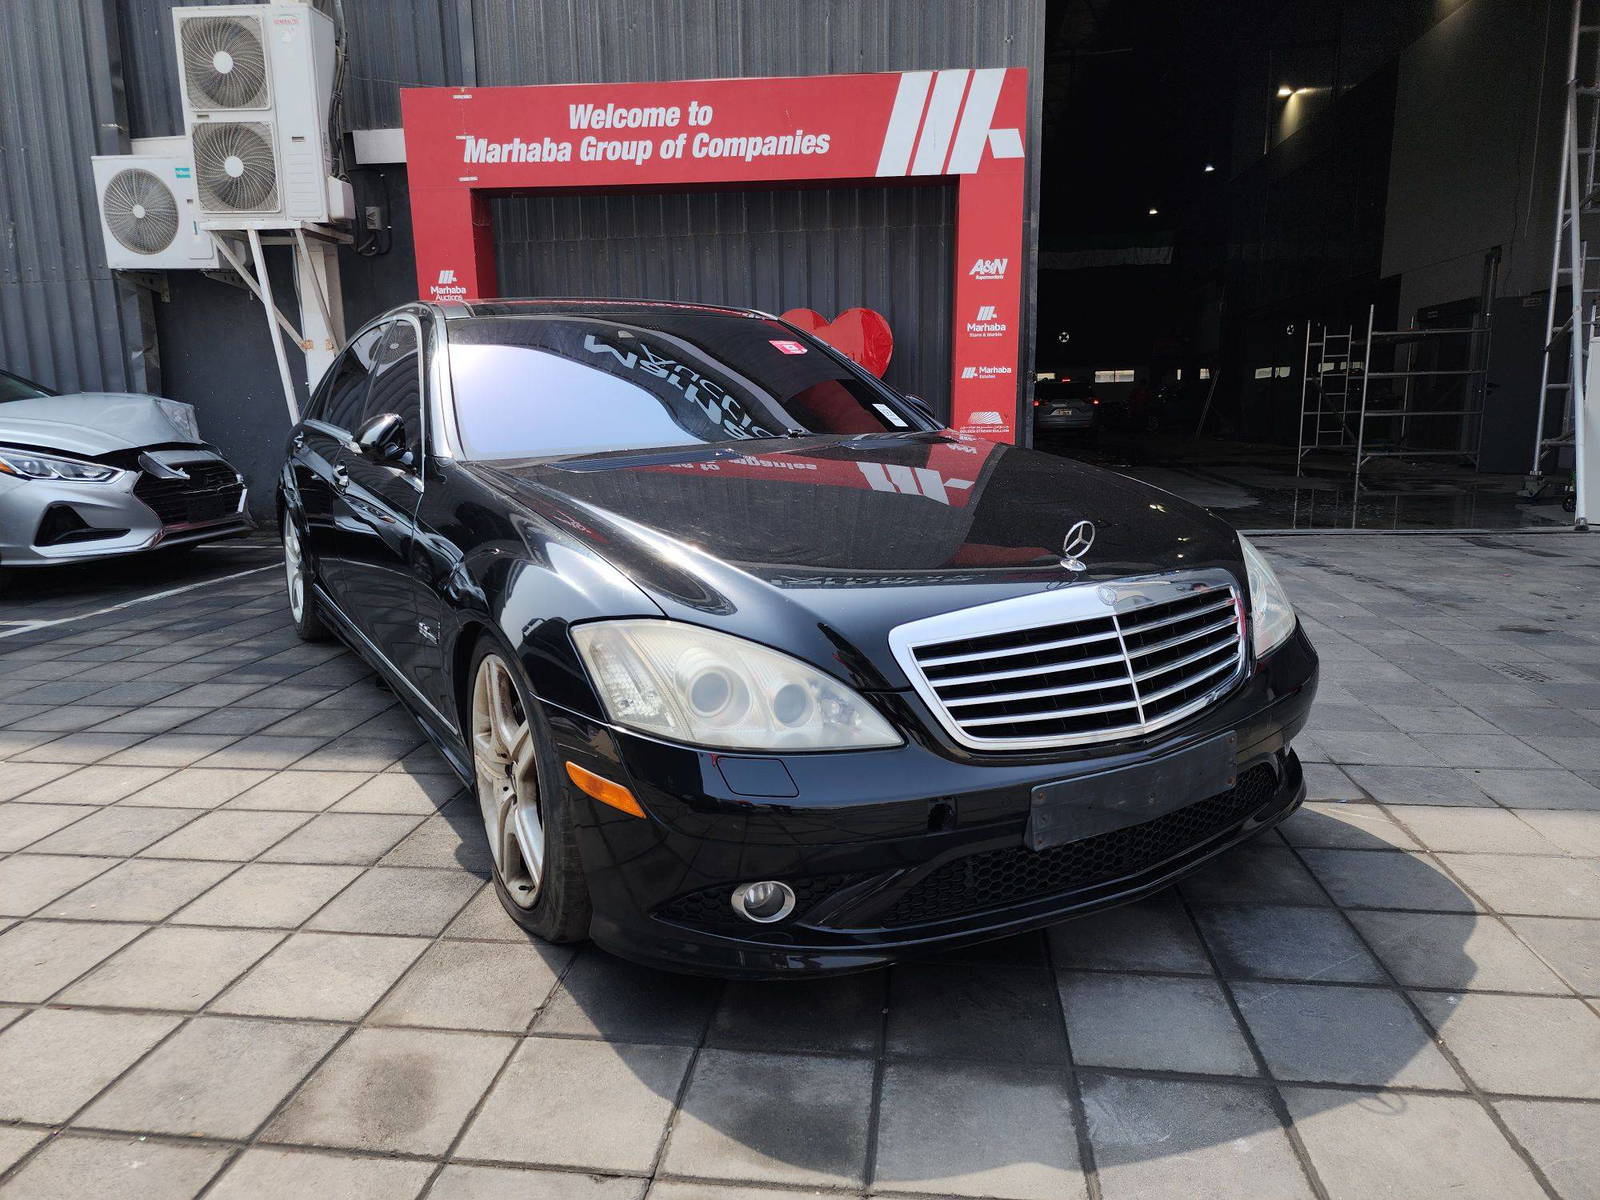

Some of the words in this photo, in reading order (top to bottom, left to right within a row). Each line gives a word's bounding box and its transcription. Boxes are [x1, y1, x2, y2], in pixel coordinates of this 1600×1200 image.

[569, 102, 681, 130] Welcome
[688, 101, 713, 126] to
[463, 136, 572, 163] Marhaba
[580, 136, 653, 166] Group
[659, 133, 688, 159] of
[692, 129, 831, 162] Companies
[968, 258, 1008, 275] A&N
[430, 285, 467, 295] Marhaba
[967, 322, 1006, 331] Marhaba
[979, 366, 1012, 374] Marhaba
